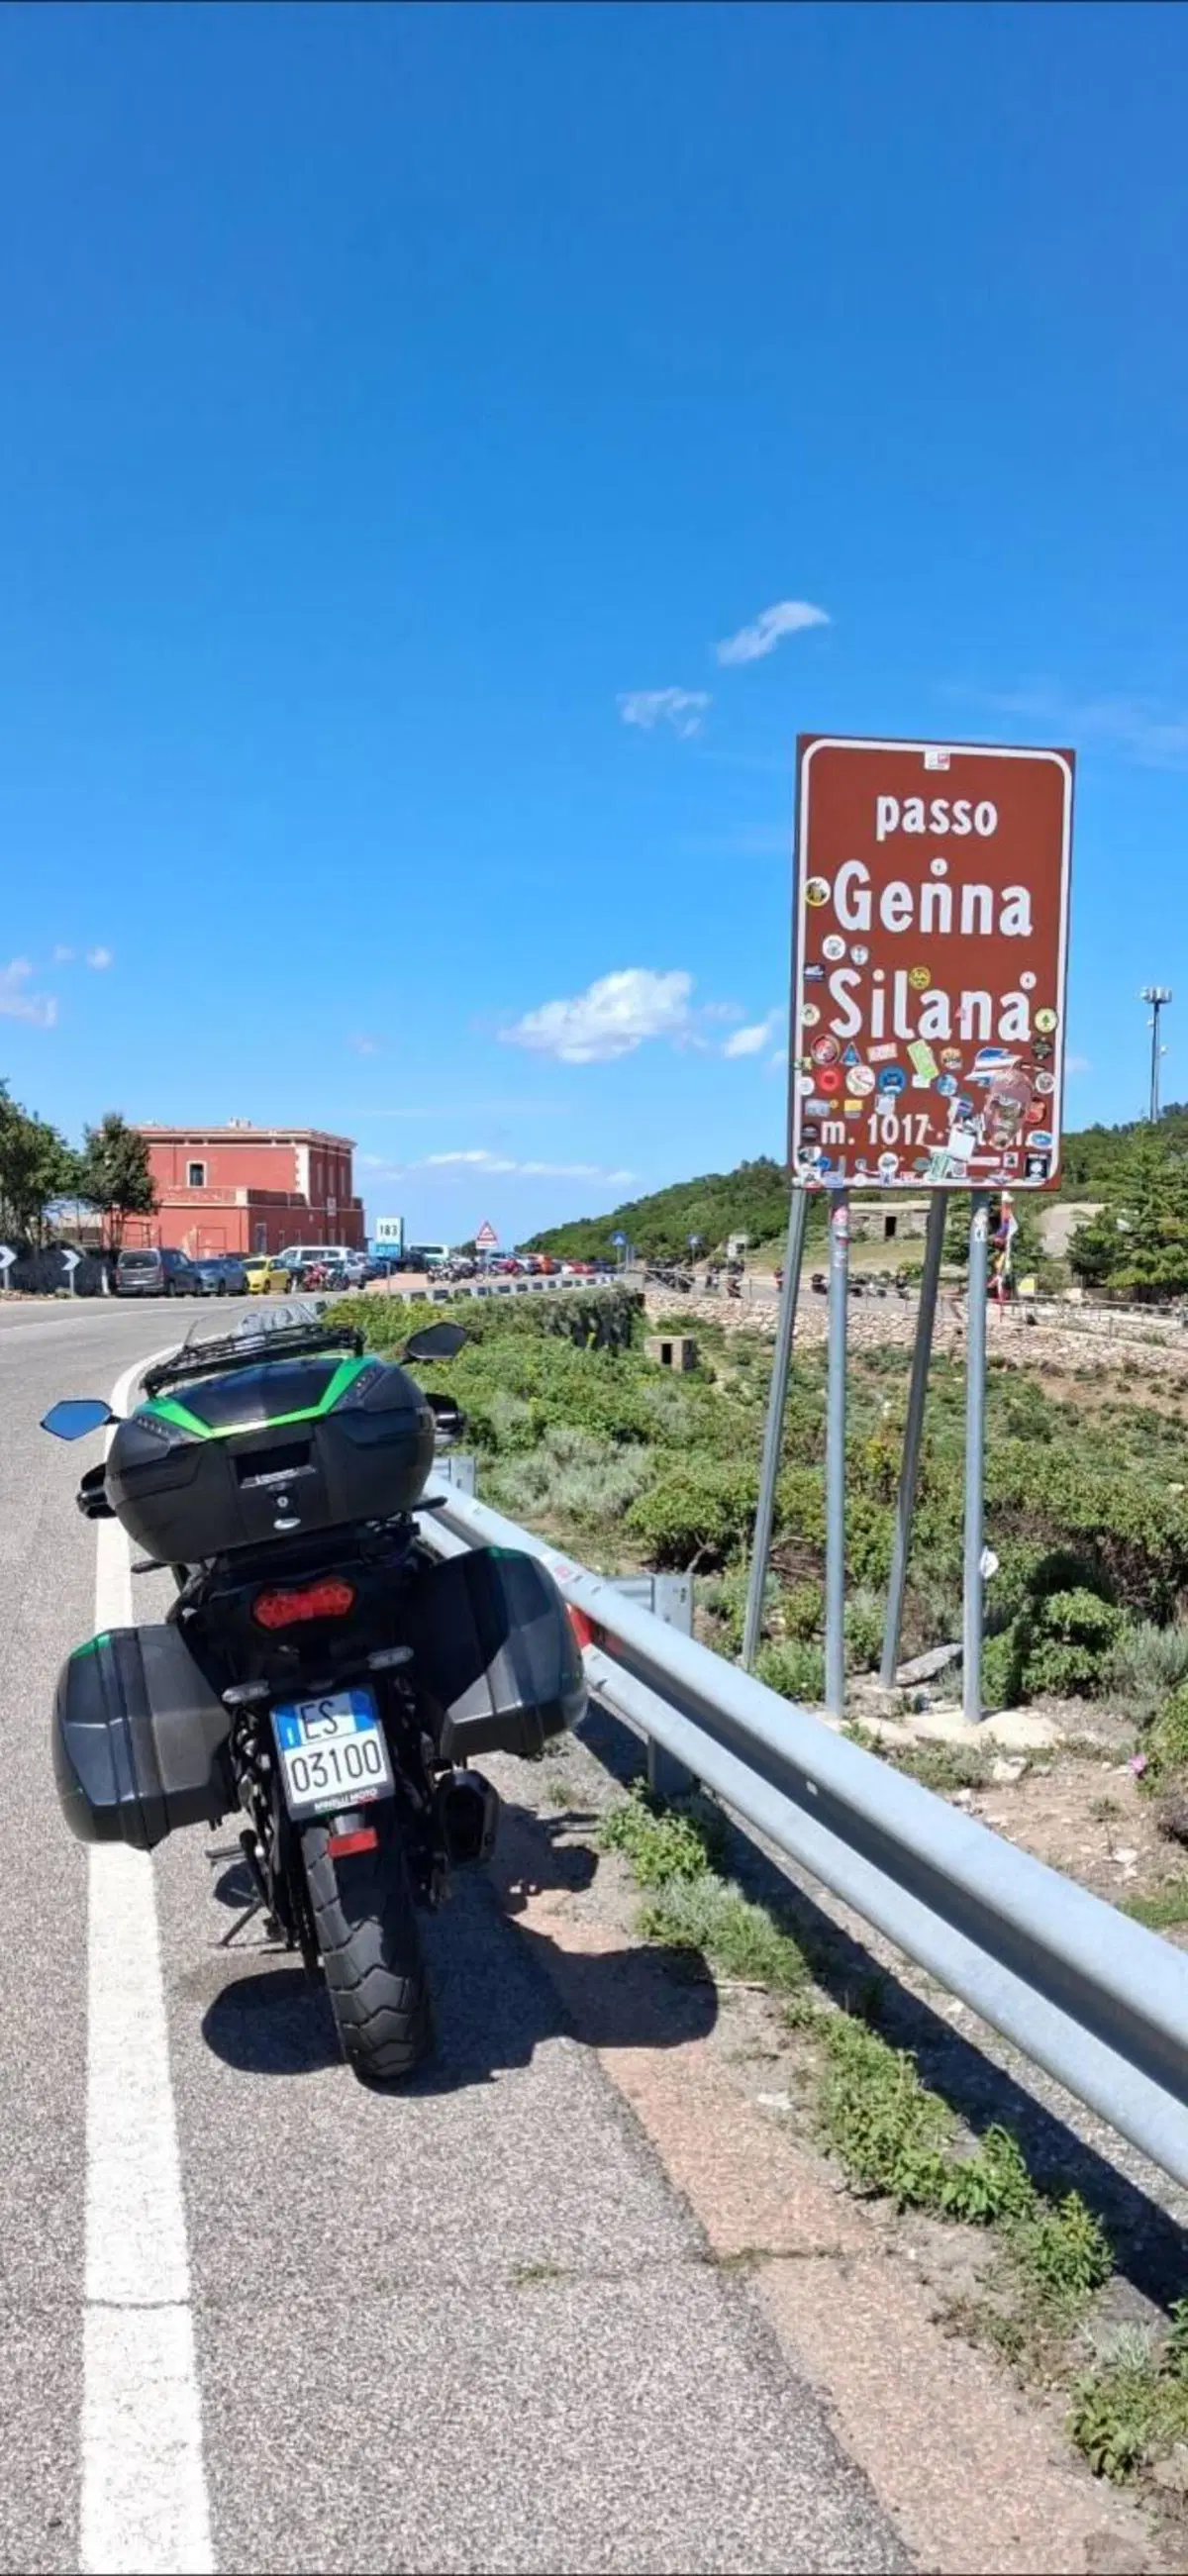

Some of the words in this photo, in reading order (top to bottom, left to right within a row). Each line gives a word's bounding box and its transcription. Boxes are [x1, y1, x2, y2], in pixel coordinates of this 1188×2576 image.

[876, 795, 998, 841] passo
[834, 859, 1033, 936] Genna
[829, 968, 1032, 1040] Silana
[822, 1121, 855, 1145] m.
[867, 1114, 929, 1145] 1017
[300, 1701, 339, 1739] ES
[291, 1739, 382, 1793] 03100
